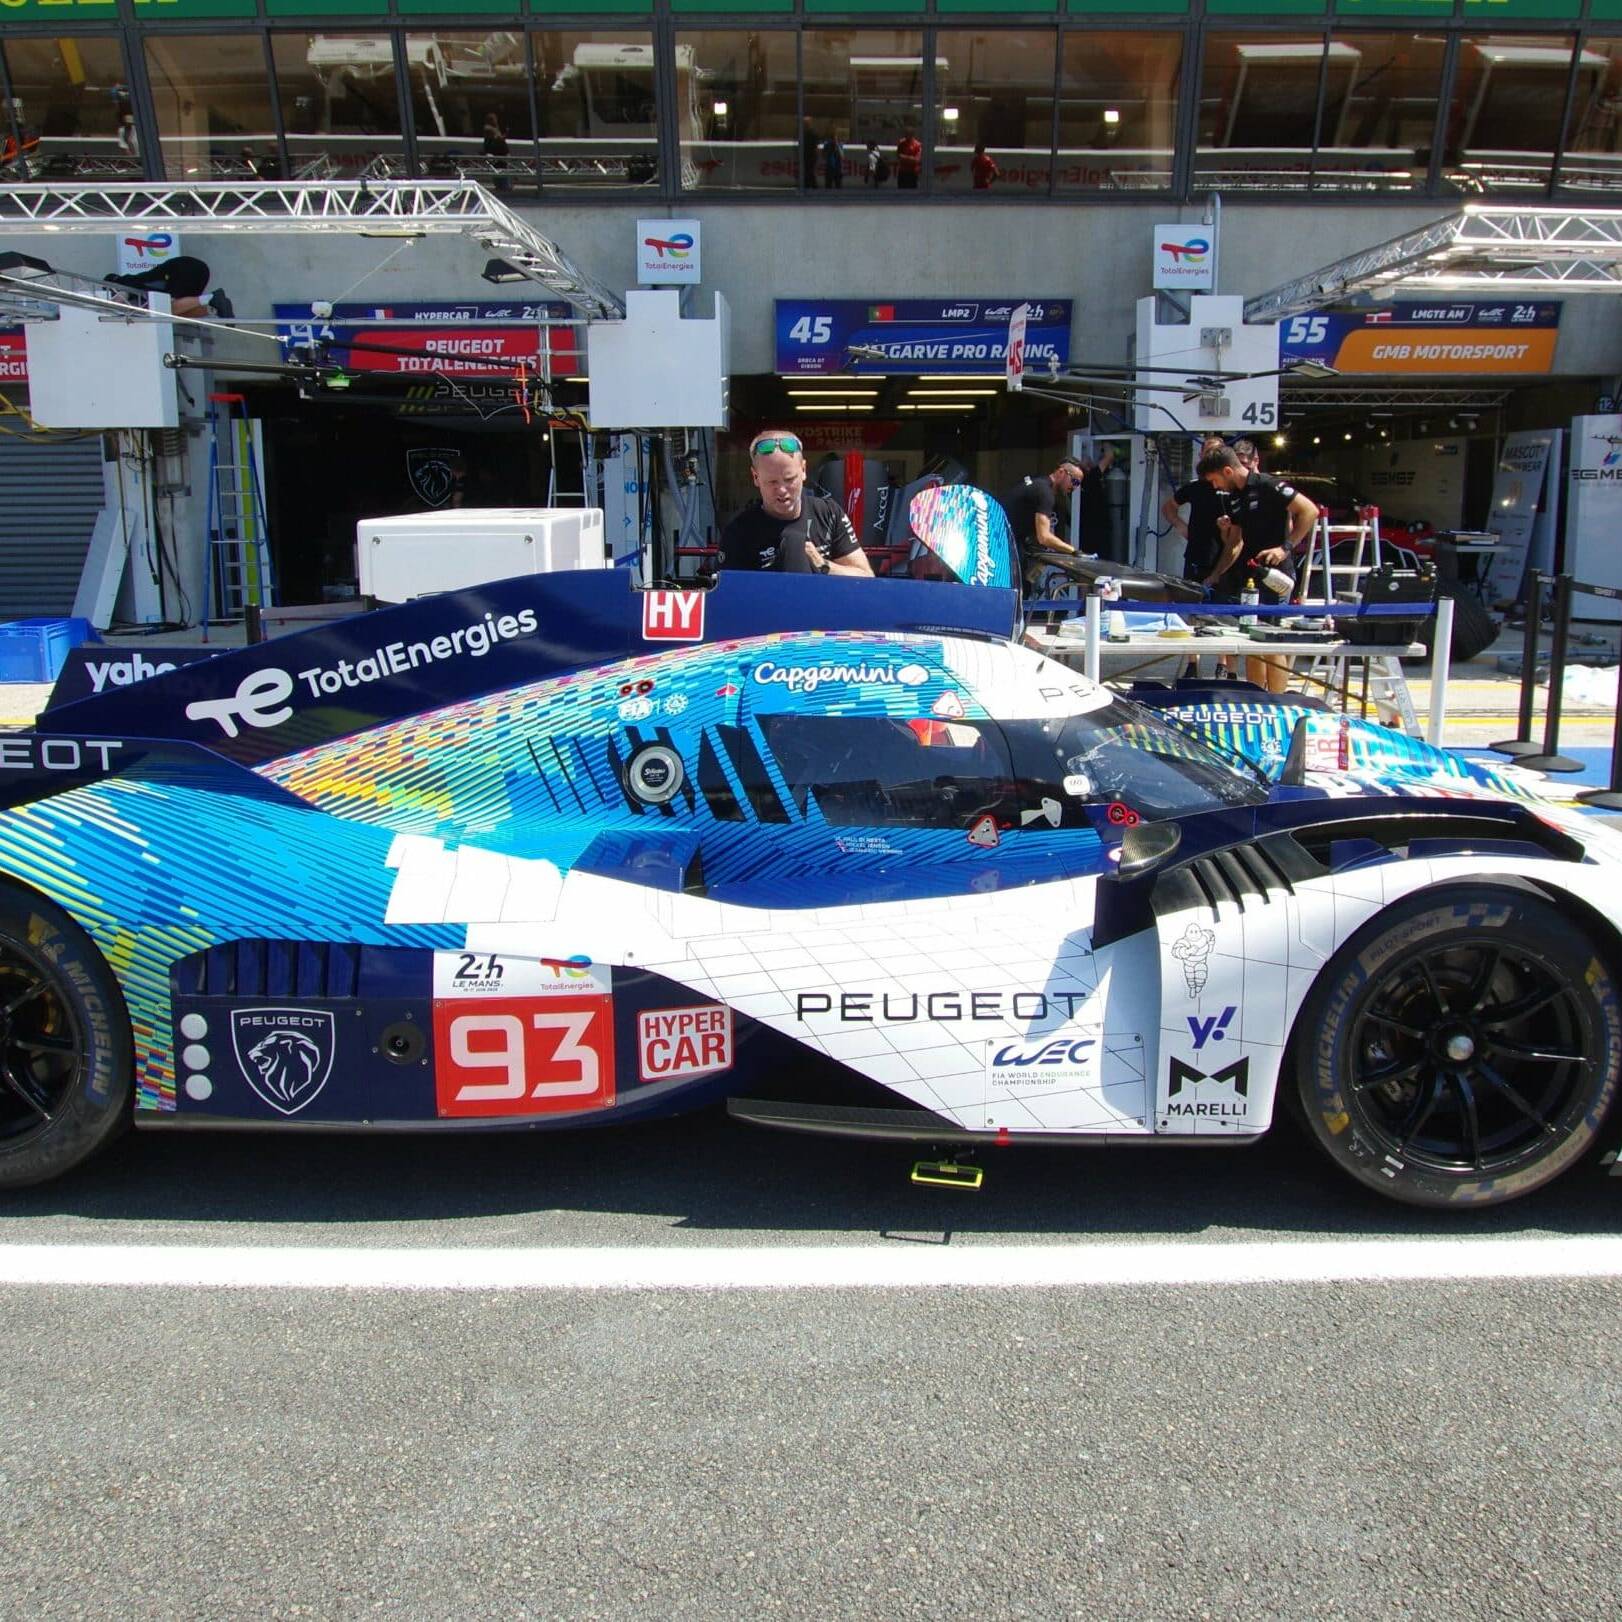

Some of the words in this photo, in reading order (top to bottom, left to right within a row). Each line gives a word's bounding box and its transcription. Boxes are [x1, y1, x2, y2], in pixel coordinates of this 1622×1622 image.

[645, 262, 694, 271] TotalEnergies
[1161, 267, 1209, 276] TotalEnergies
[415, 311, 470, 320] HYPERCAR
[941, 309, 970, 318] LMP2
[1412, 310, 1445, 319] LMGTE
[1447, 310, 1464, 319] AM
[789, 316, 832, 343] 45
[1286, 316, 1329, 343] 55
[426, 339, 505, 353] PEUGEOT
[951, 344, 988, 359] PRO
[1372, 345, 1410, 359] GMB
[1413, 345, 1529, 360] MOTORSPORT
[1242, 401, 1275, 425] 45
[872, 486, 889, 533] Accel
[648, 591, 700, 629] HY
[298, 608, 539, 698] TotalEnergies
[754, 662, 895, 692] Capgemini
[1163, 710, 1275, 725] PEUGEOT
[0, 739, 123, 771] EOT
[1402, 917, 1441, 938] SPORT
[455, 953, 504, 979] 24h
[468, 980, 501, 988] MANS
[540, 982, 594, 991] TotalEnergies
[797, 992, 1085, 1021] PEUGEOT
[63, 959, 113, 1096] MICHELIN
[240, 1016, 325, 1027] PEUGEOT
[645, 1011, 725, 1039] HYPER
[1318, 972, 1359, 1090] MICHELIN
[450, 1011, 599, 1100] 93
[646, 1033, 726, 1073] CAR
[993, 1039, 1096, 1066] WEC
[1167, 1103, 1247, 1116] MARELLI
